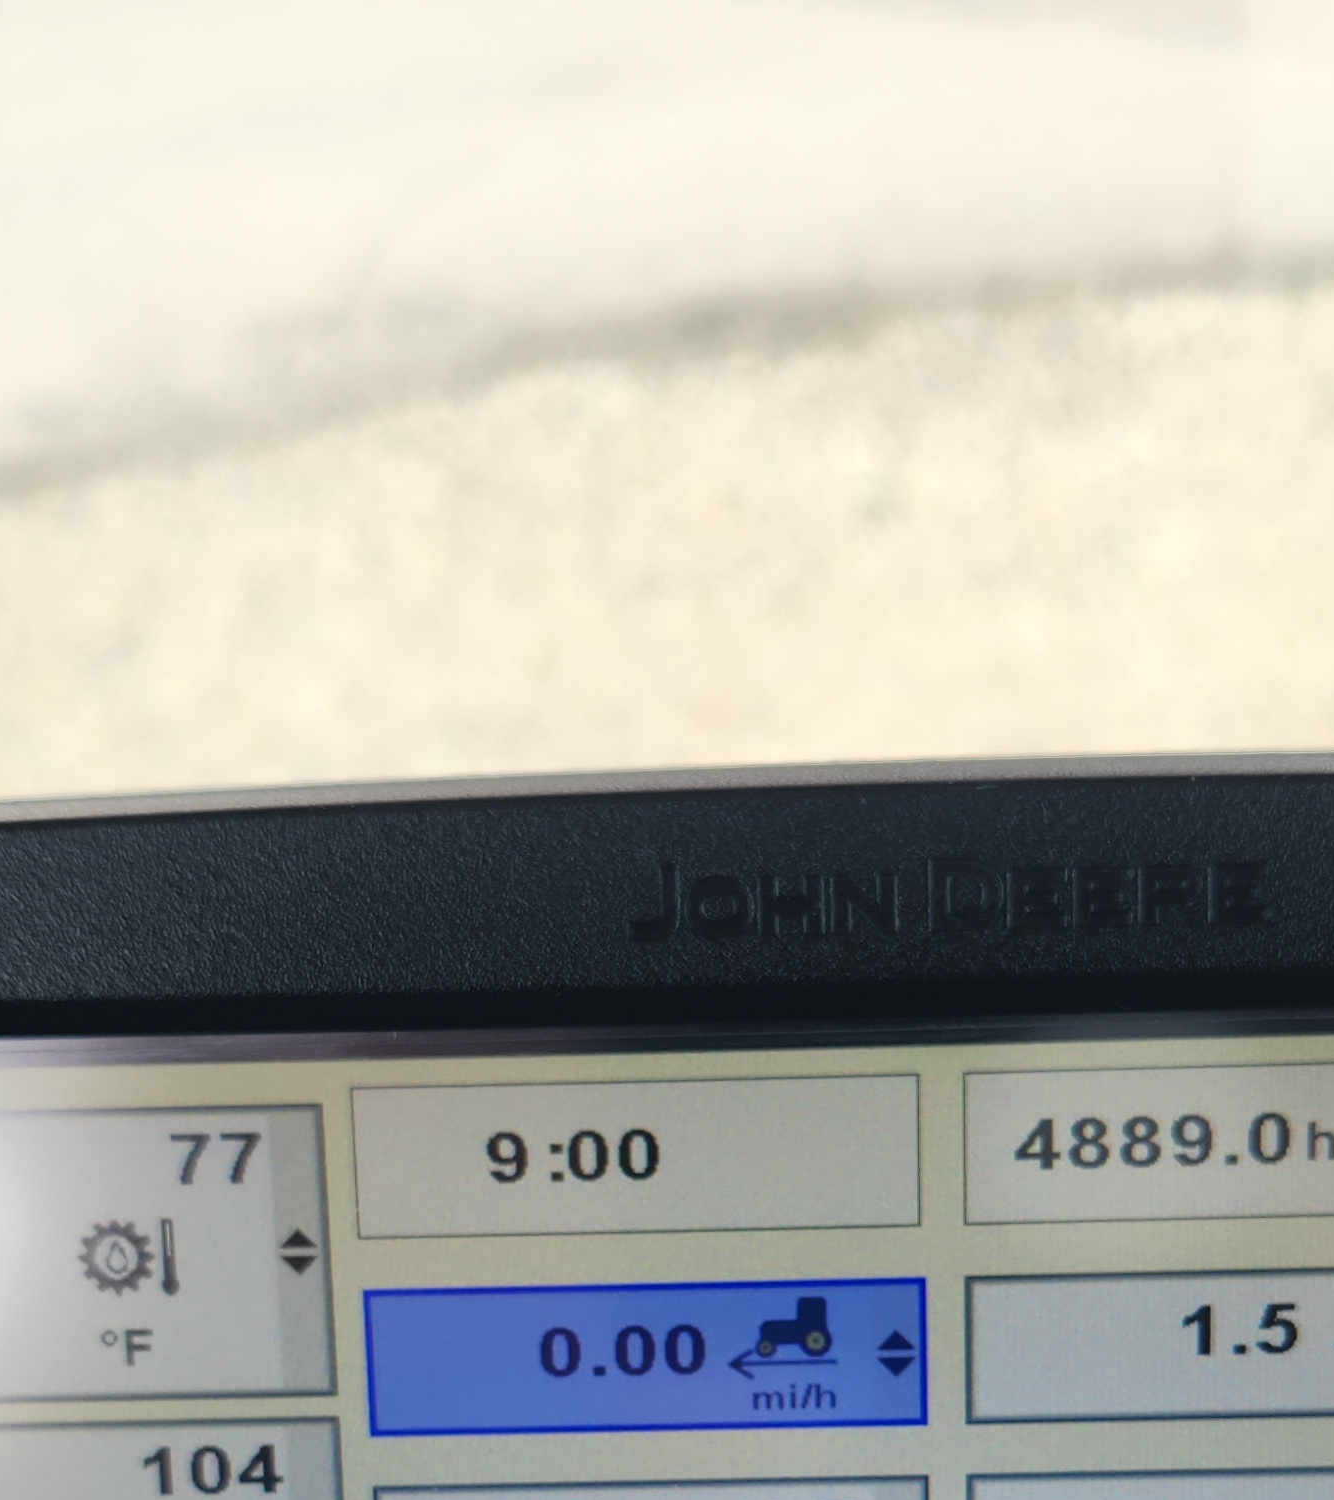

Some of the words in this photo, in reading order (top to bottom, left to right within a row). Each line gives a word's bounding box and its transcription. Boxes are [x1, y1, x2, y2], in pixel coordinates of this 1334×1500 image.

[628, 859, 898, 941] JOHN
[928, 857, 1267, 932] DEERE
[170, 1132, 261, 1185] 77
[486, 1129, 659, 1183] 9:00
[101, 1329, 153, 1366] °F
[540, 1324, 706, 1378] 0.00
[1182, 1303, 1299, 1356] 1.5
[752, 1384, 837, 1411] mi/h
[143, 1445, 283, 1495] 104
